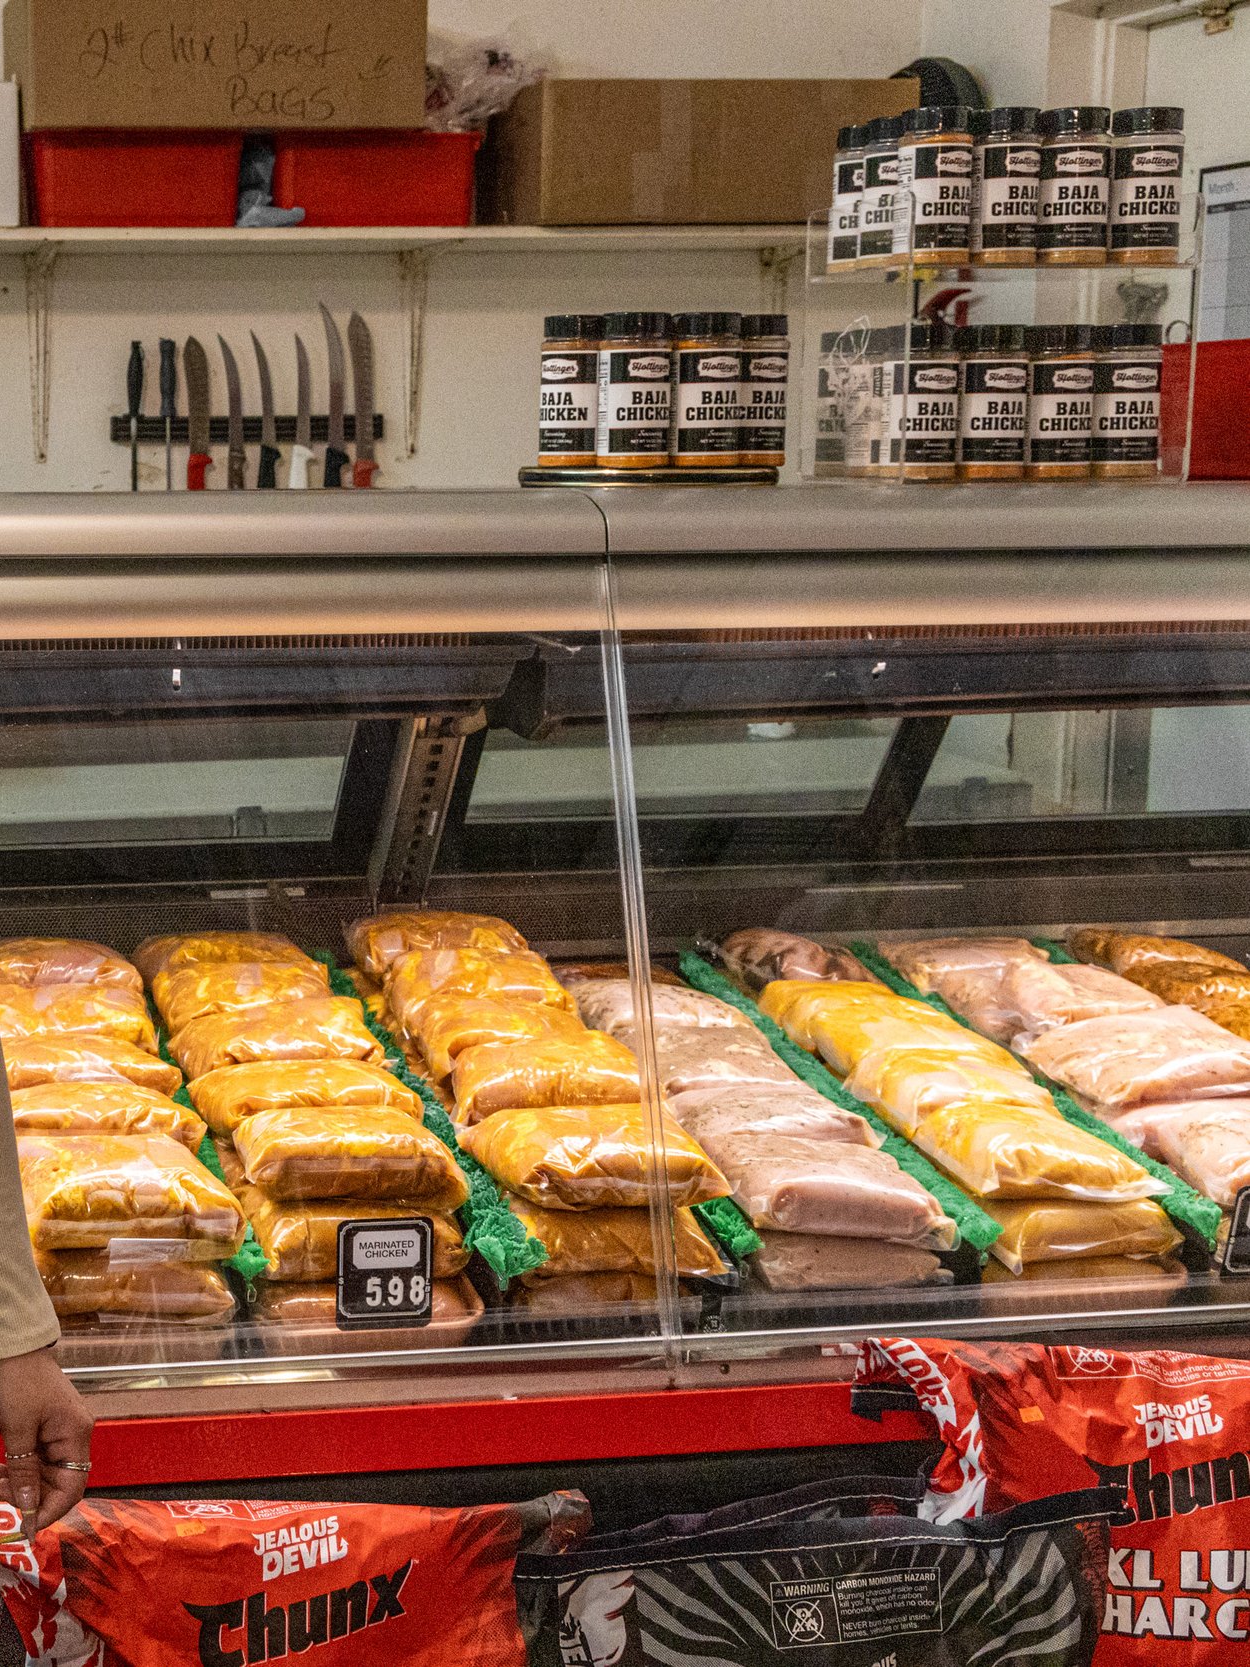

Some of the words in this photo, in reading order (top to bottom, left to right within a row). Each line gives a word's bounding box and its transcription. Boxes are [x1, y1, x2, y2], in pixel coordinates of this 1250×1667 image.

[1058, 185, 1099, 200] BAJA
[1134, 185, 1175, 200] BAJA
[991, 202, 1037, 216] CHICK
[542, 392, 573, 405] BAJA
[632, 391, 668, 405] BAJA
[701, 390, 737, 405] BAJA
[616, 407, 670, 421] CHICKE
[686, 406, 739, 421] CHICKE
[987, 401, 1023, 415] BAJA
[1115, 401, 1154, 415] BAJA
[898, 418, 958, 431] CHICKE
[970, 416, 1024, 431] CHICKE
[1039, 417, 1092, 431] CHICKE
[358, 1240, 415, 1250] MARINATED
[365, 1249, 408, 1259] CHICKEN
[366, 1275, 425, 1307] 5.98
[1165, 1372, 1201, 1384] vehicles
[1213, 1368, 1241, 1377] tents.
[1183, 1363, 1223, 1375] charcoal
[1132, 1394, 1213, 1426] JEALOUS
[1144, 1411, 1225, 1449] DEVIL
[252, 1516, 340, 1556] JEALOUS
[262, 1535, 349, 1582] DEVIL
[783, 1582, 830, 1598] WARNING
[835, 1577, 868, 1590] CARBON
[868, 1574, 903, 1587] MONOXIDE
[904, 1573, 936, 1582] HAZARD
[838, 1590, 865, 1600] Burning
[896, 1592, 923, 1601] carbon
[182, 1558, 414, 1667] Chunx
[842, 1621, 868, 1631] NEVER
